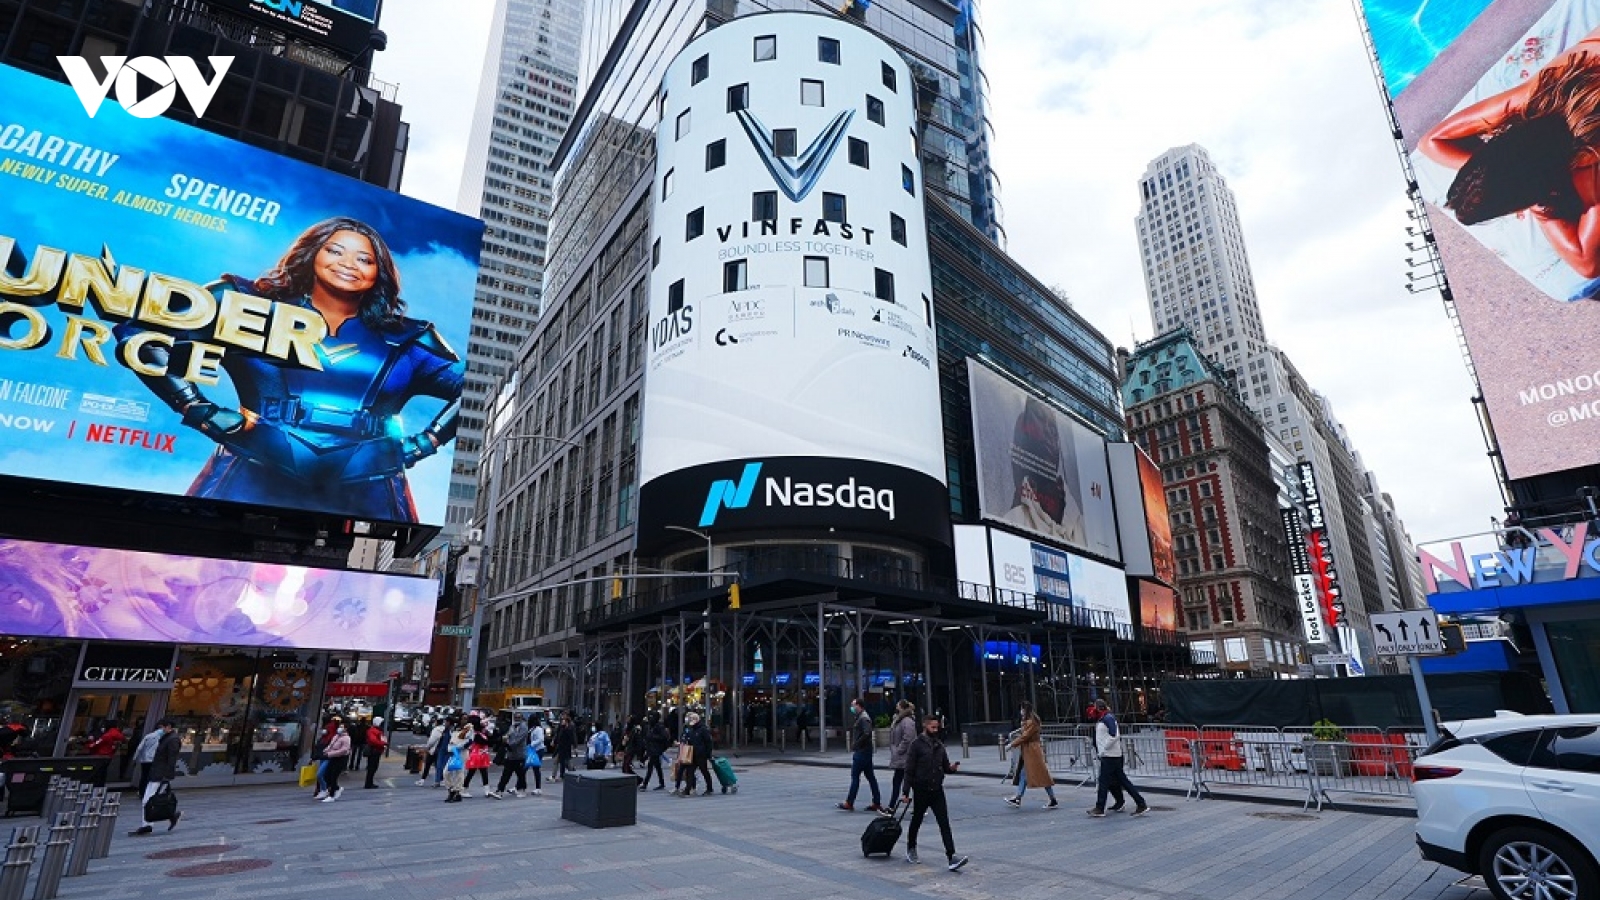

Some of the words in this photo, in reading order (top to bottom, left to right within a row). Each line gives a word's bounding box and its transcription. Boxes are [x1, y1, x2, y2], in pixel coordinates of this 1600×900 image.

[0, 123, 120, 177] CARTHY
[0, 157, 57, 185] NEWLY
[56, 173, 109, 201] SUPER.
[112, 189, 174, 217] ALMOST
[173, 206, 227, 233] HEROES.
[165, 173, 281, 226] SPENCER
[716, 217, 875, 245] VINFAST
[718, 240, 801, 261] BOUNDLESS
[805, 240, 875, 263] TOGETHER
[0, 301, 226, 386] ORCE
[13, 382, 72, 409] FALCONE
[0, 413, 56, 433] NOW
[86, 423, 177, 453] NETFLIX
[1301, 464, 1318, 501] Locker
[765, 476, 895, 520] Nasdaq
[1308, 502, 1324, 528] Foot
[1003, 562, 1026, 585] 825
[1416, 541, 1537, 594] NEW
[1300, 577, 1315, 613] Locker
[1307, 617, 1321, 641] Foot
[1377, 645, 1394, 653] ONLY
[1398, 643, 1417, 652] ONLY
[1419, 642, 1439, 651] ONLY
[84, 666, 171, 682] CITIZEN
